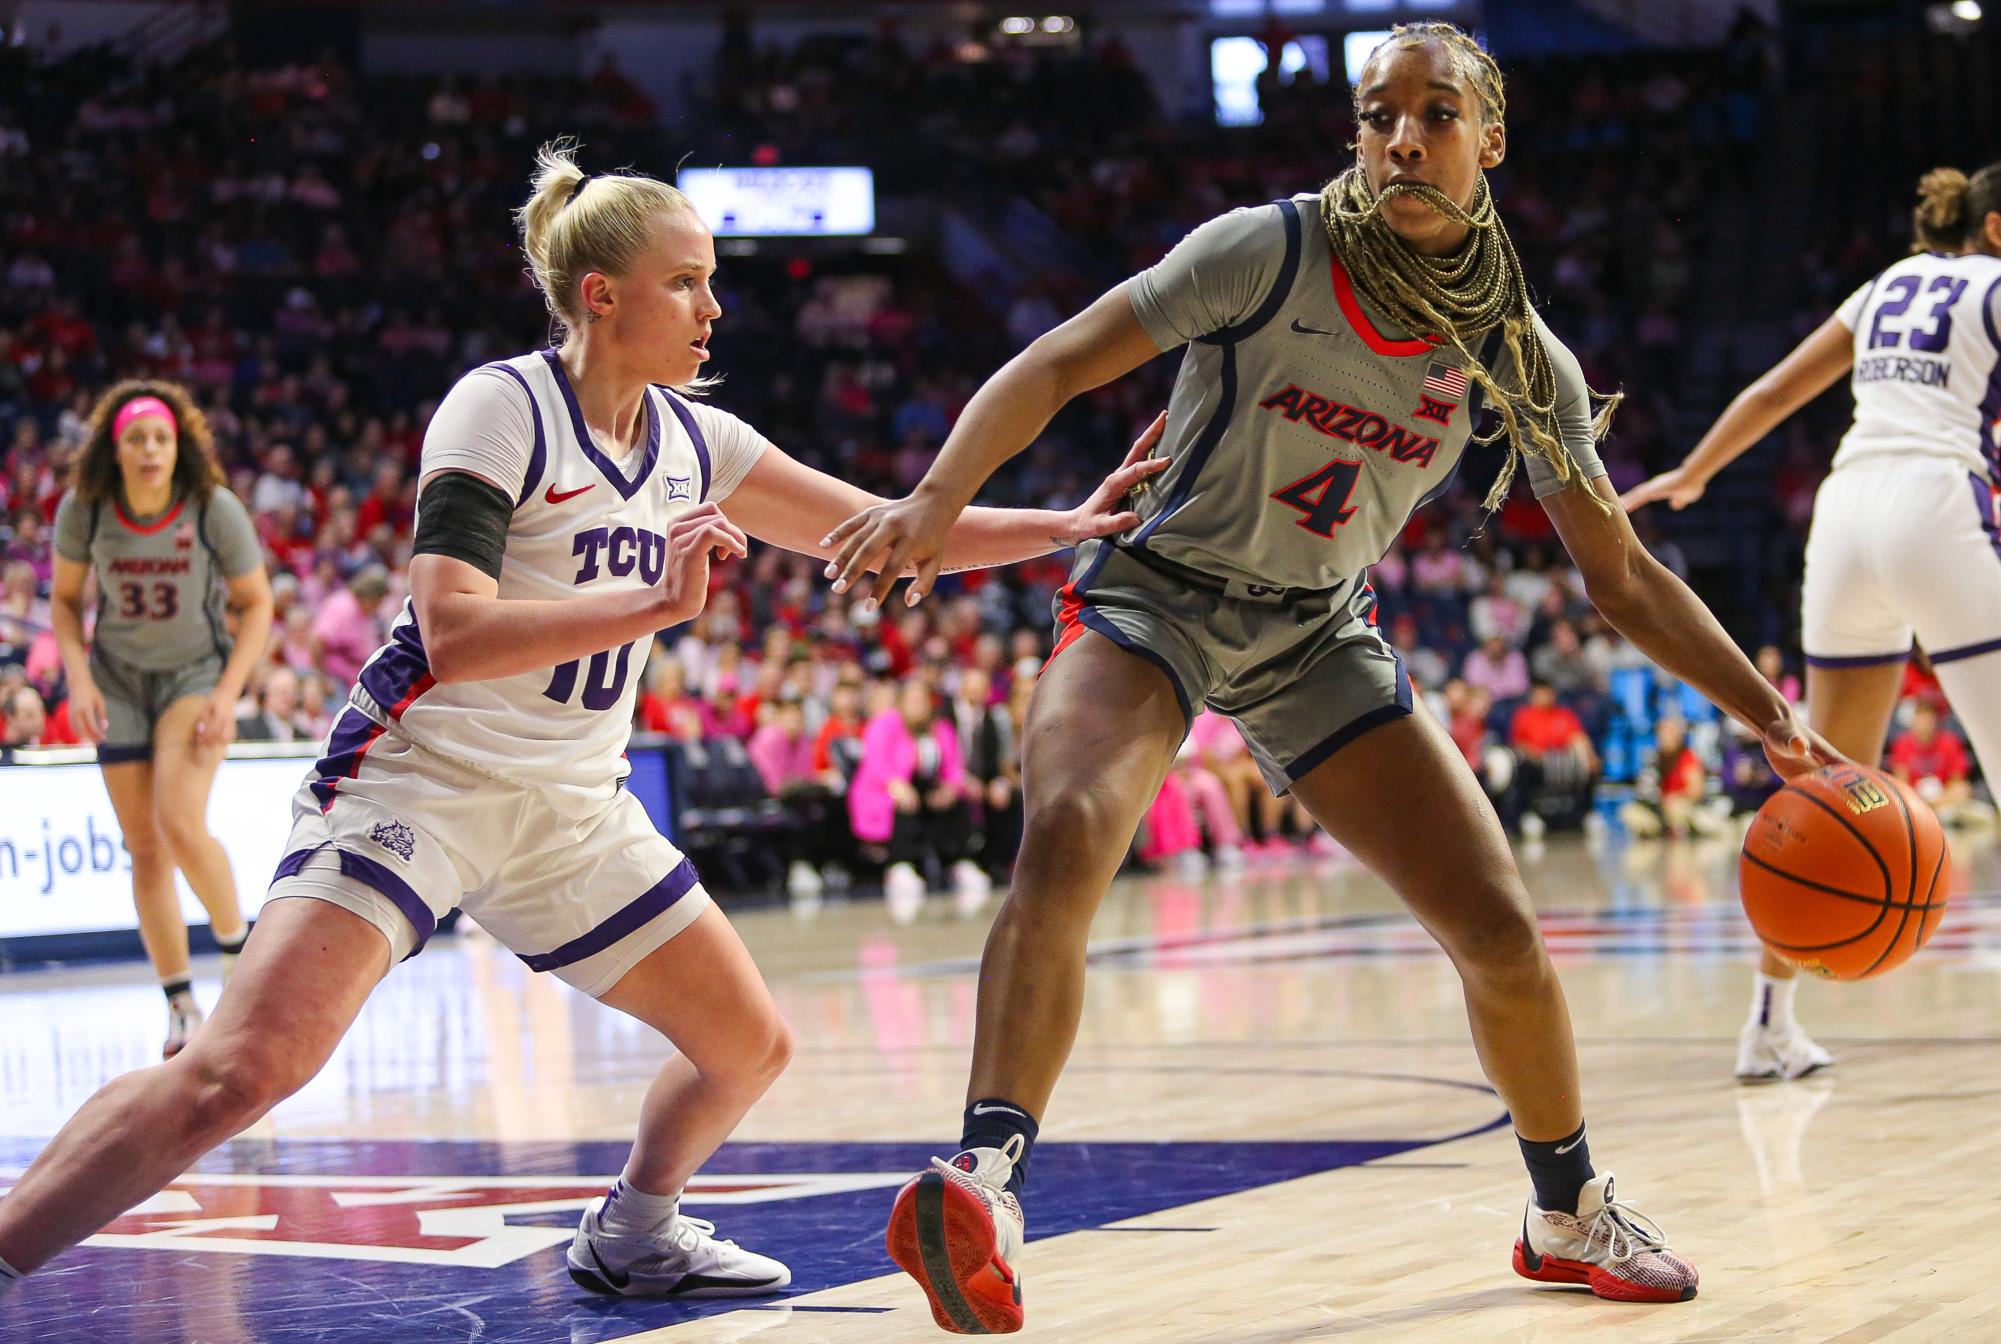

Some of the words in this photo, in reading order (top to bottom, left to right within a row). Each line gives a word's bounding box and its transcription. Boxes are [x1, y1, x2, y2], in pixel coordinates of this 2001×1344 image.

[1869, 275, 1969, 353] 23
[1259, 383, 1440, 469] ARIZONA
[1269, 458, 1359, 540] 4
[572, 527, 666, 587] TCU
[120, 581, 178, 621] 33
